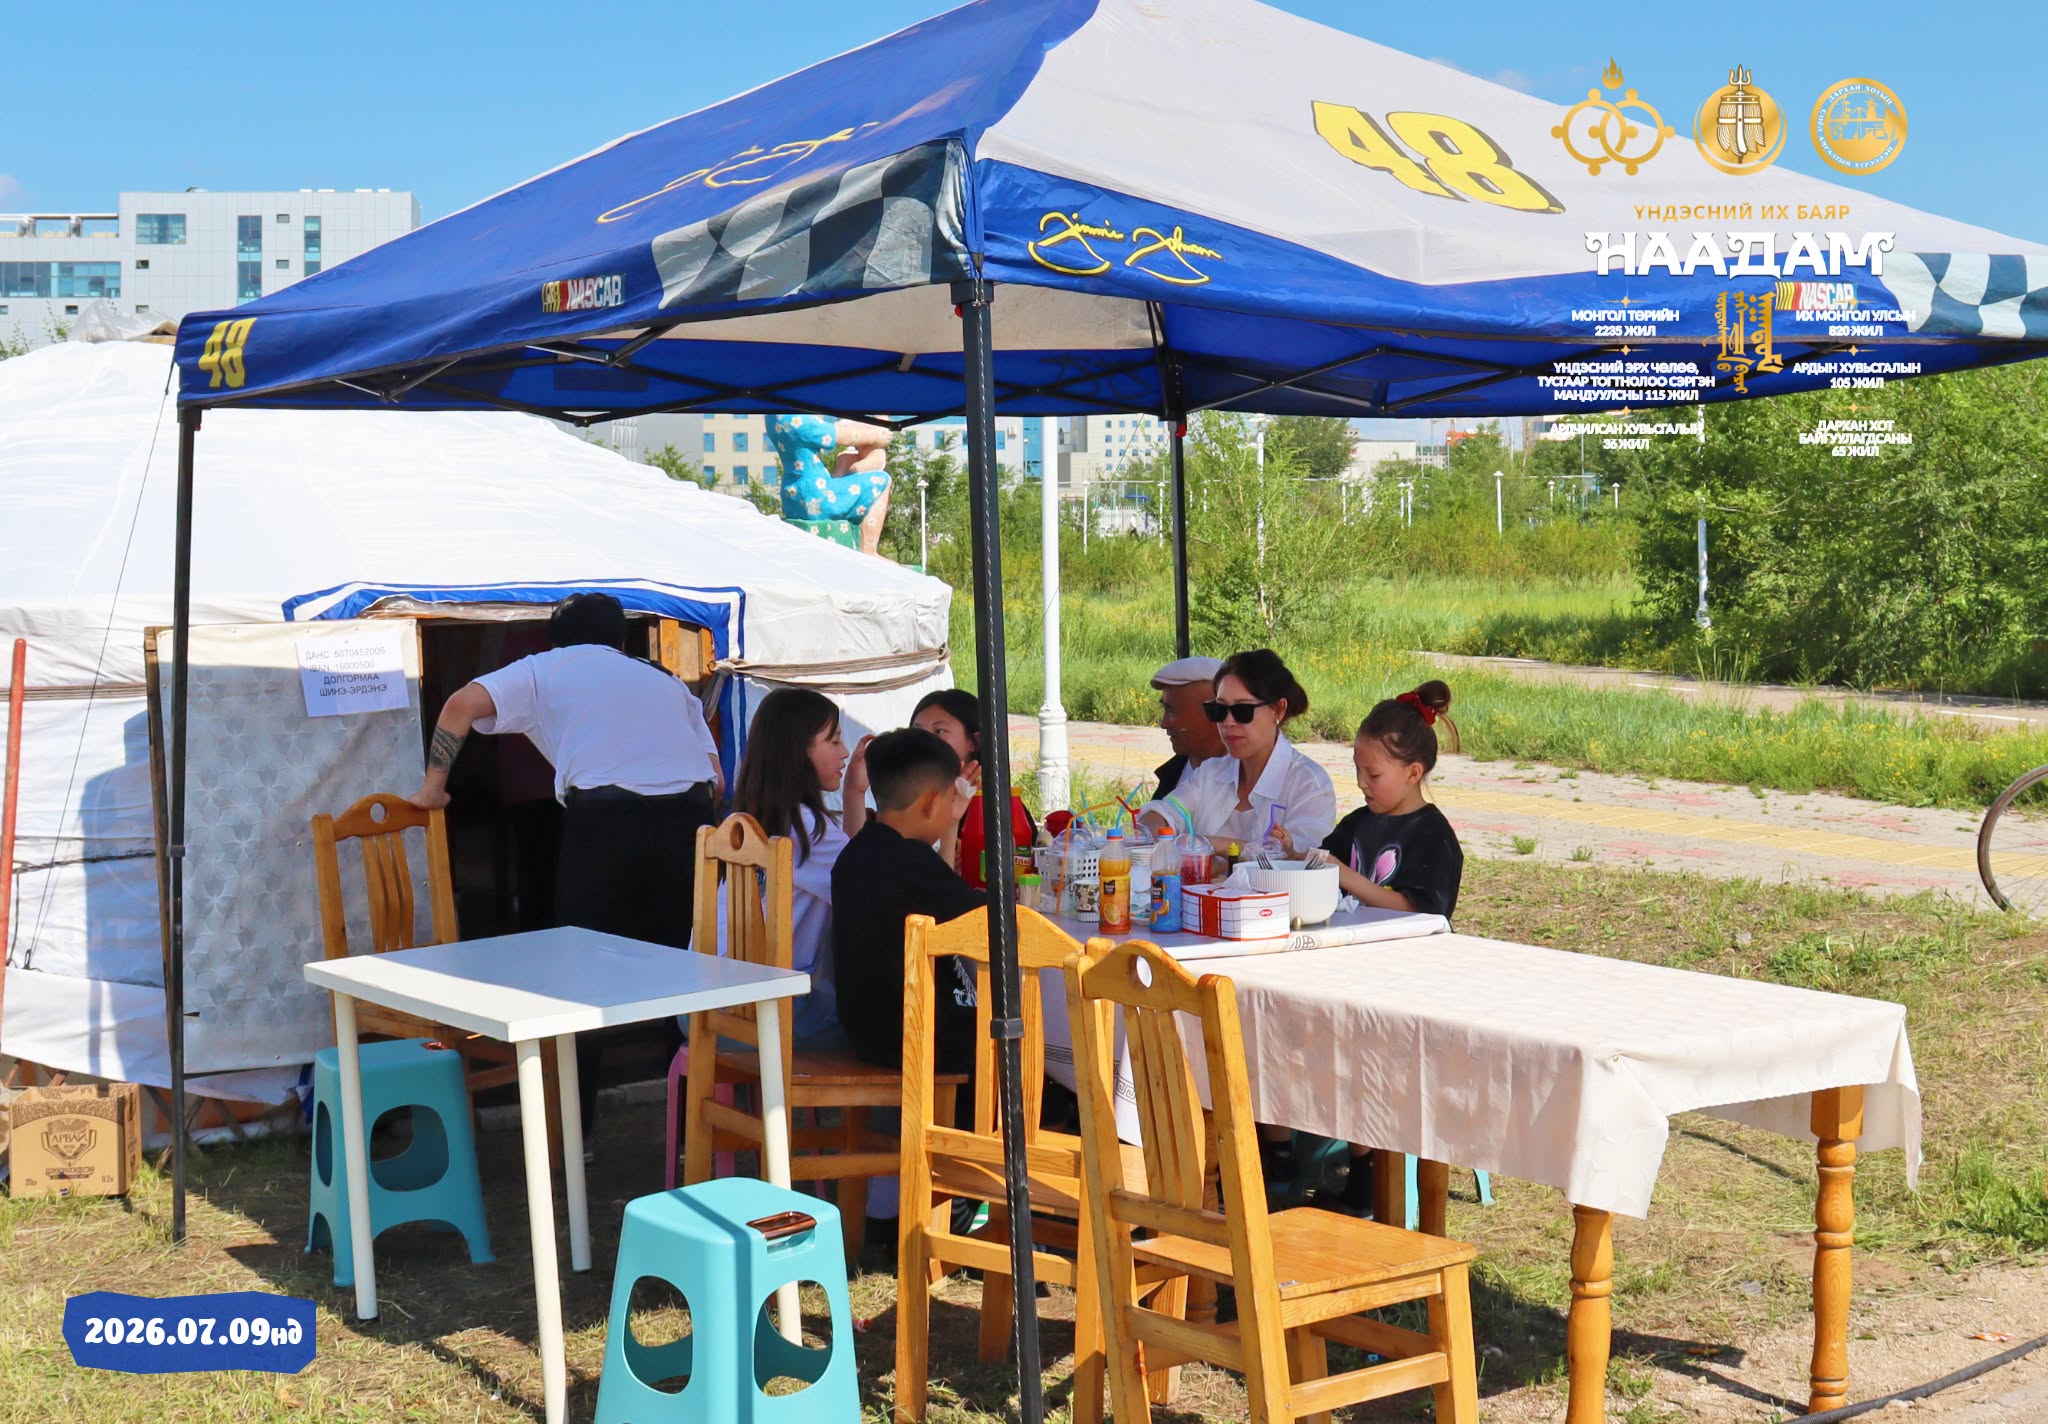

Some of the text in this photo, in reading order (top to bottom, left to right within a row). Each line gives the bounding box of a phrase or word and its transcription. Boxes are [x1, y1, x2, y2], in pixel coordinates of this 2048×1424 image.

[1311, 100, 1566, 214] 48
[567, 275, 622, 311] NASCAR
[1799, 282, 1855, 310] NASCAR
[198, 318, 258, 388] 48
